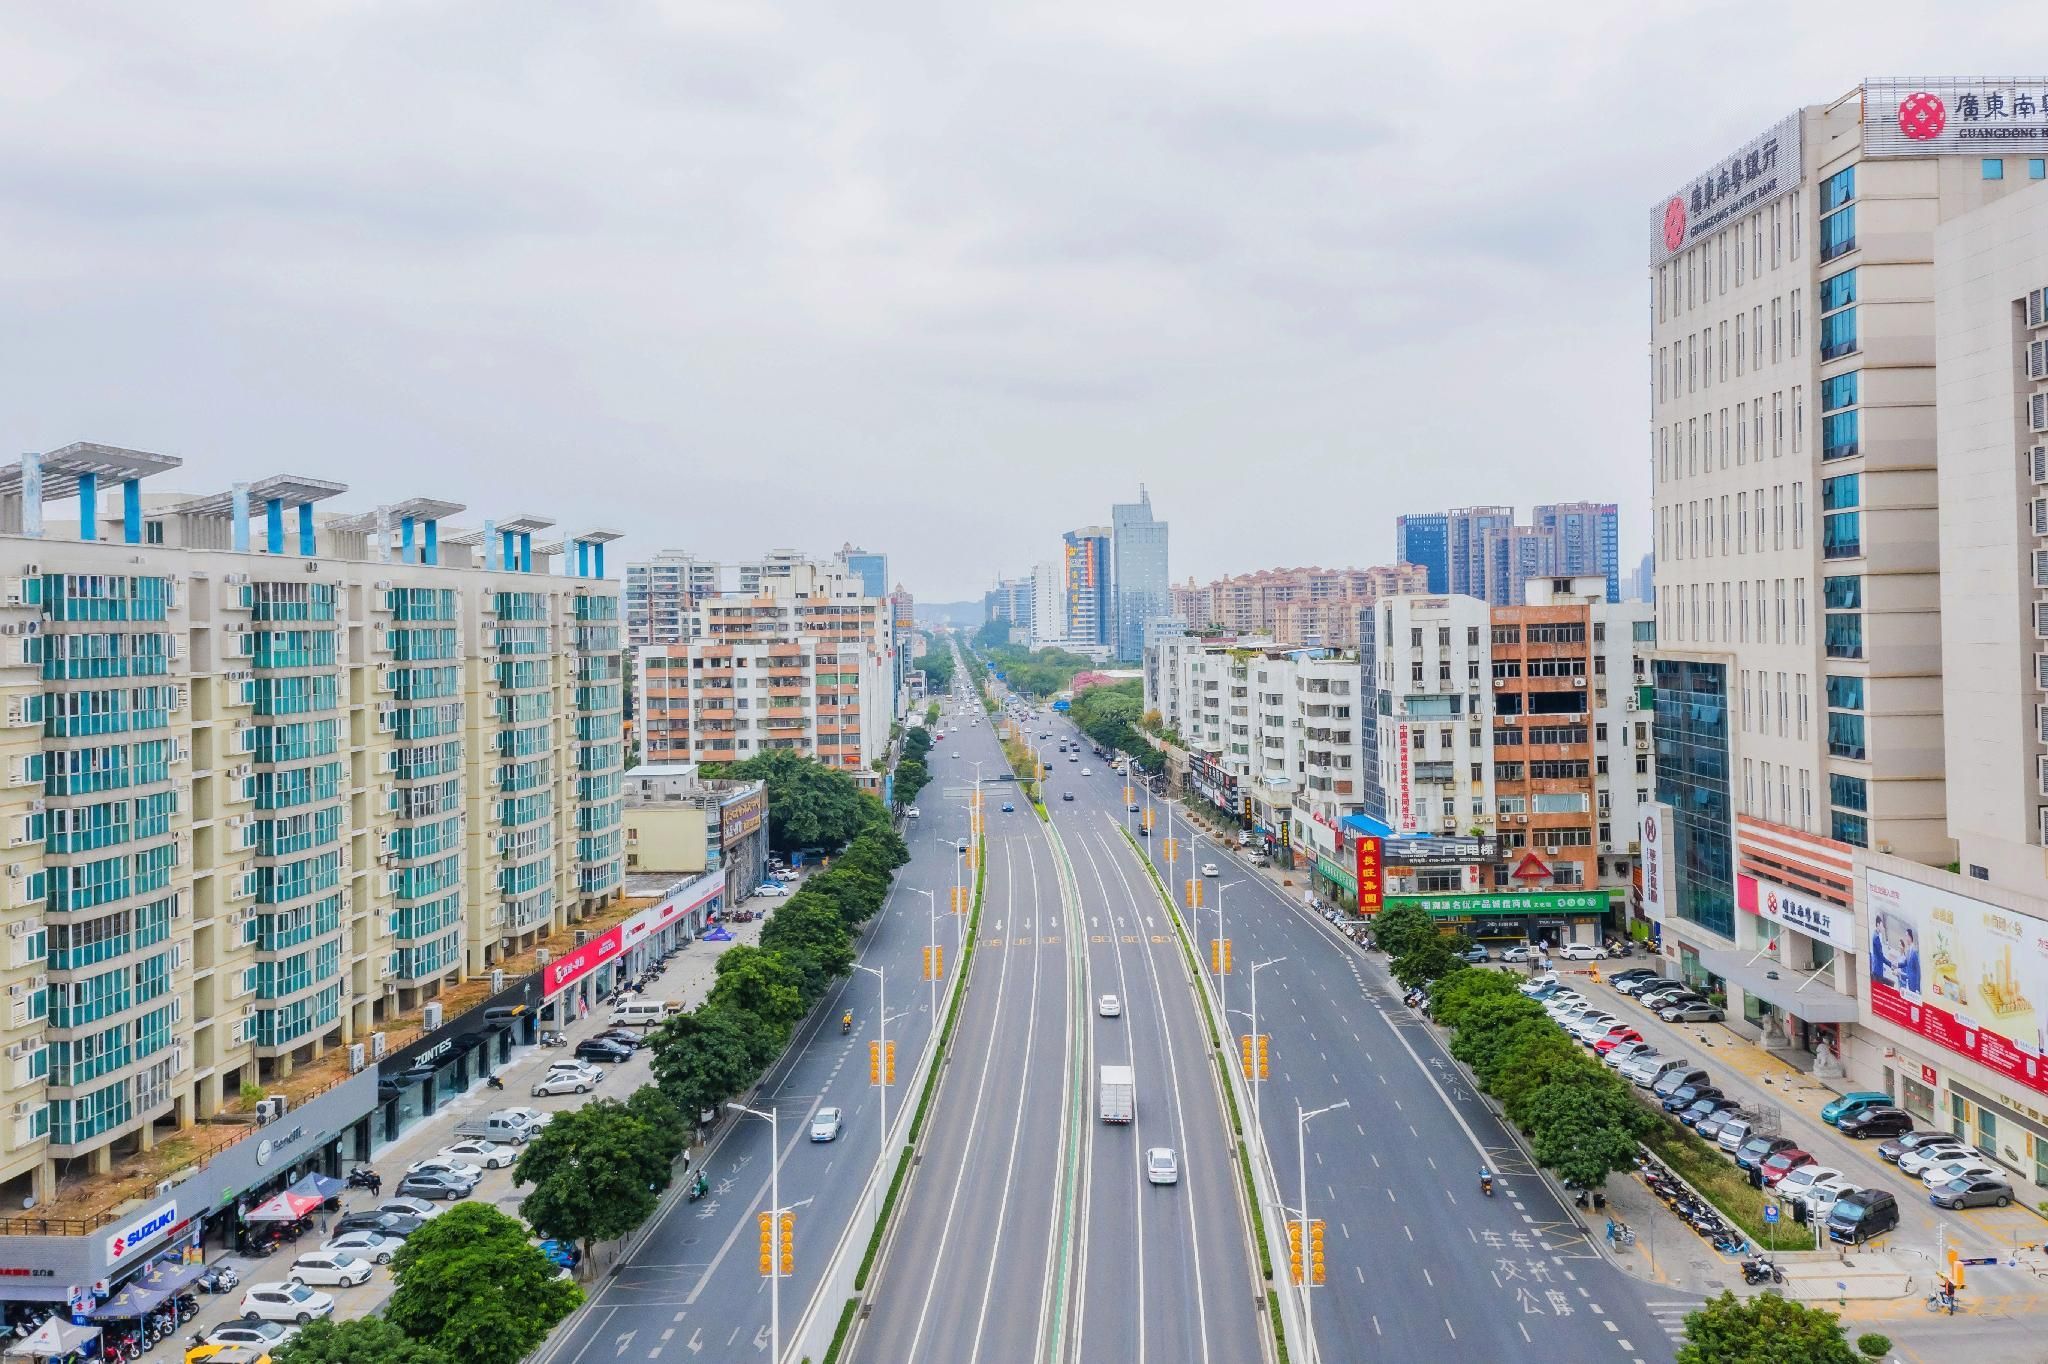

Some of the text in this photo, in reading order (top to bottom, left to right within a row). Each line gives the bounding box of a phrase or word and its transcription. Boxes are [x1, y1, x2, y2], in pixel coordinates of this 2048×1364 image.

[1959, 128, 2037, 139] GUANGDONG
[414, 1037, 453, 1069] ZONTES
[127, 1209, 175, 1247] SUZUKI
